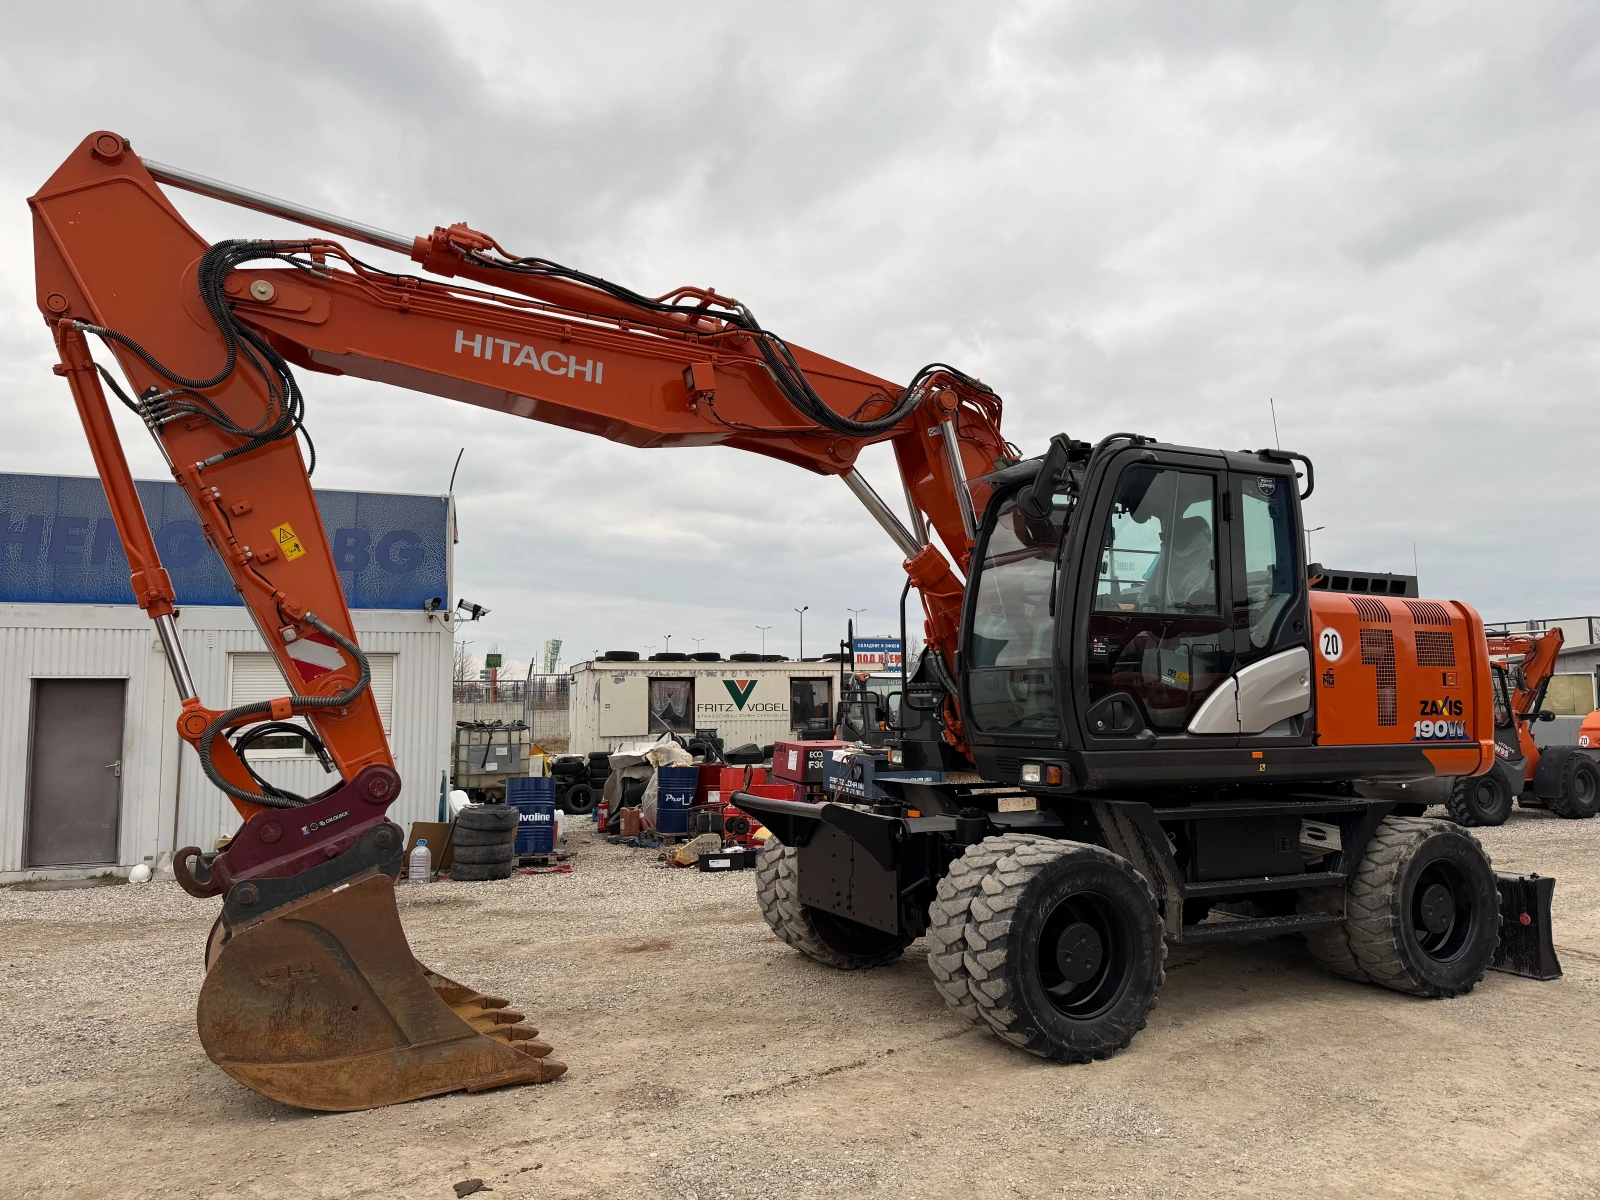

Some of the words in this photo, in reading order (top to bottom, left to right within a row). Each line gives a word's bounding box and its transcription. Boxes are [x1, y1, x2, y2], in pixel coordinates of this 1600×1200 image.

[454, 329, 604, 384] HITACHI
[1324, 633, 1339, 655] 20
[856, 653, 875, 663] ПОД
[697, 703, 734, 712] FRITZ
[746, 702, 789, 712] VOGEL
[1419, 695, 1463, 717] ZAXIS
[1413, 719, 1467, 738] 190W
[1498, 740, 1516, 754] HITACHI
[1580, 737, 1588, 745] 20
[325, 810, 350, 824] OILQUICK
